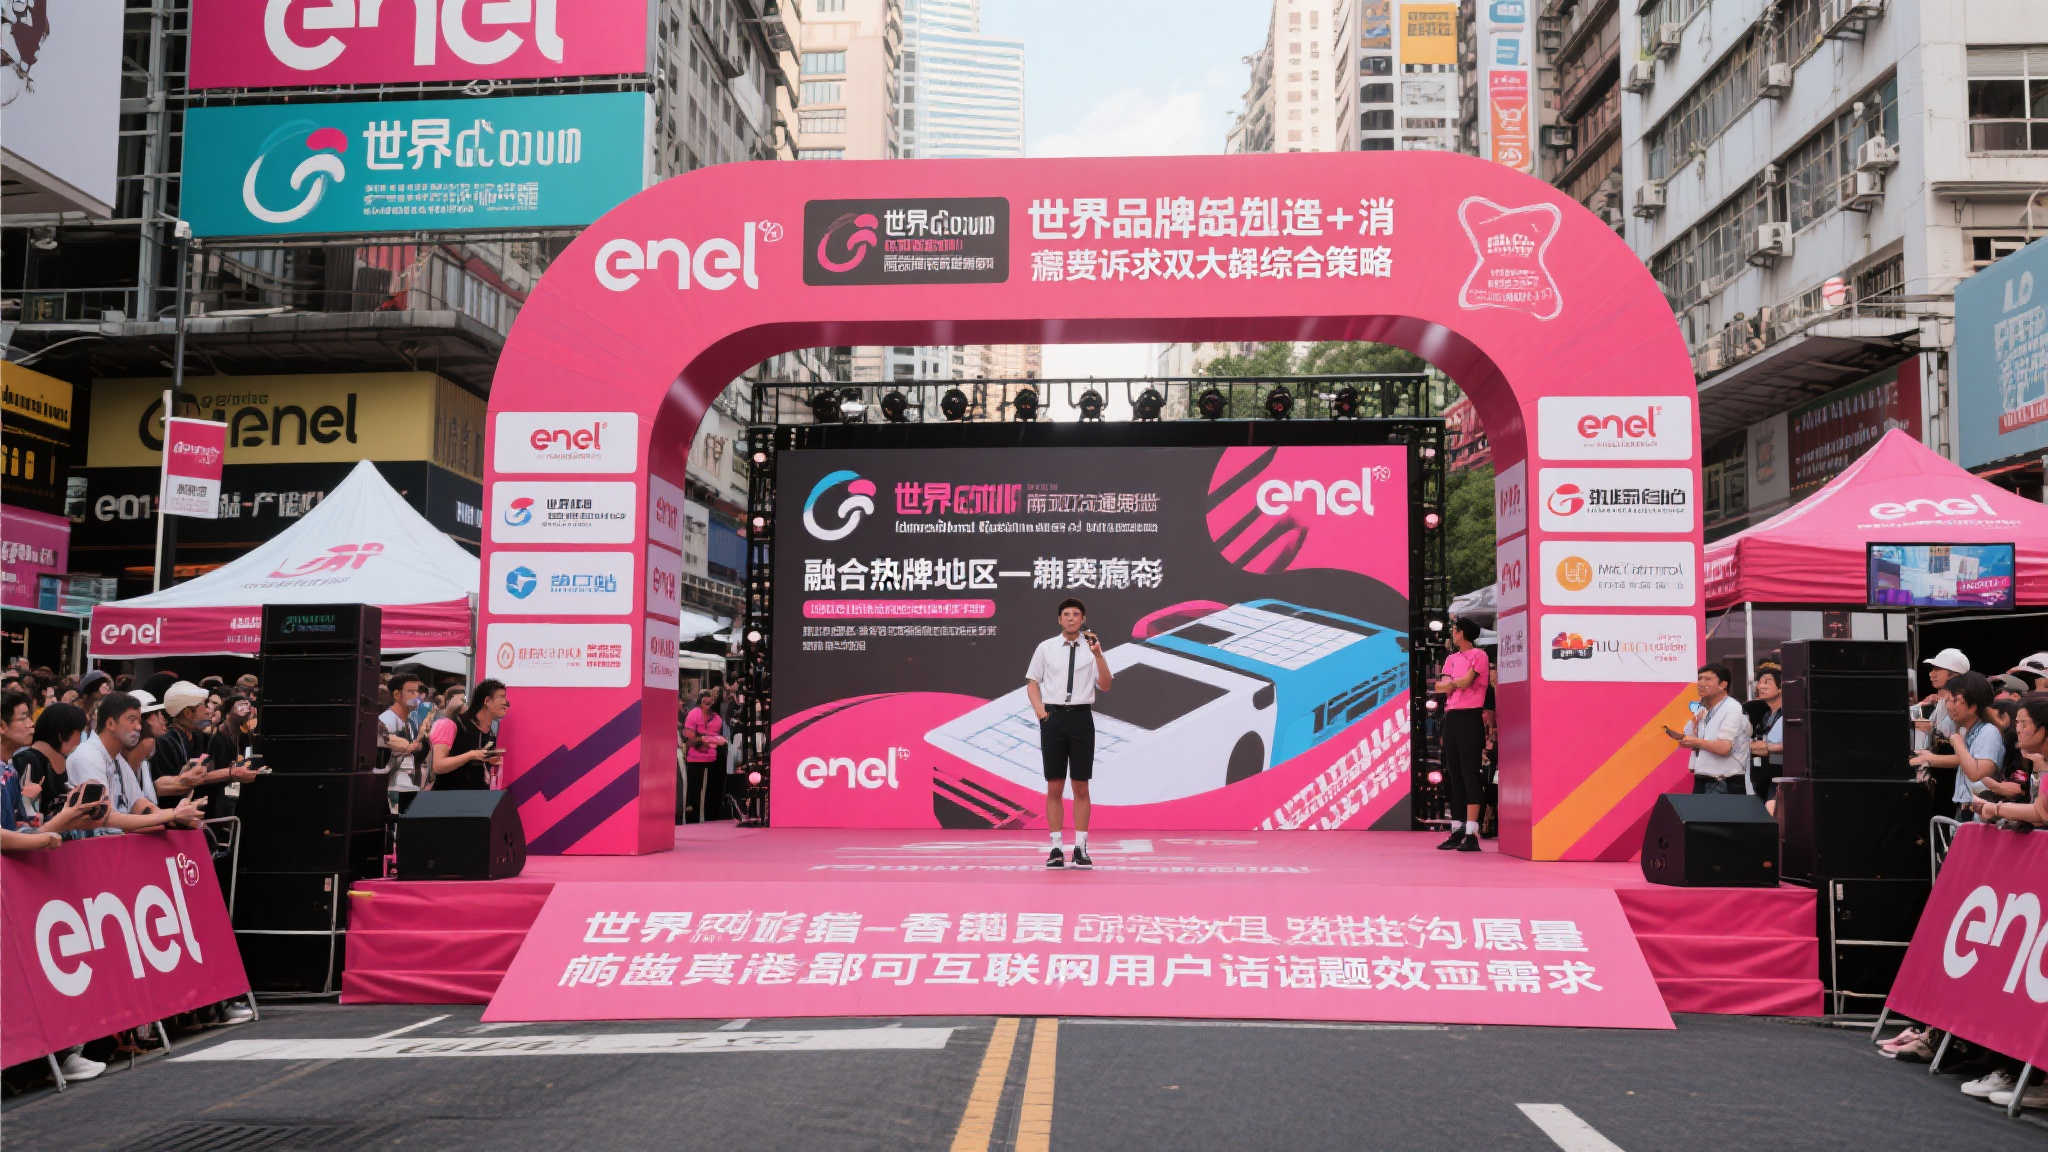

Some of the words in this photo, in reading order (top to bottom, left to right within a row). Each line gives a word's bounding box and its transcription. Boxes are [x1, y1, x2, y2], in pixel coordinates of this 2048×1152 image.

[594, 221, 759, 292] enel
[530, 422, 602, 451] enel
[1577, 406, 1657, 439] enel
[1256, 467, 1374, 516] enel
[1869, 493, 1998, 521] enel
[100, 617, 162, 645] enel
[797, 747, 898, 789] enel
[36, 857, 203, 997] enel
